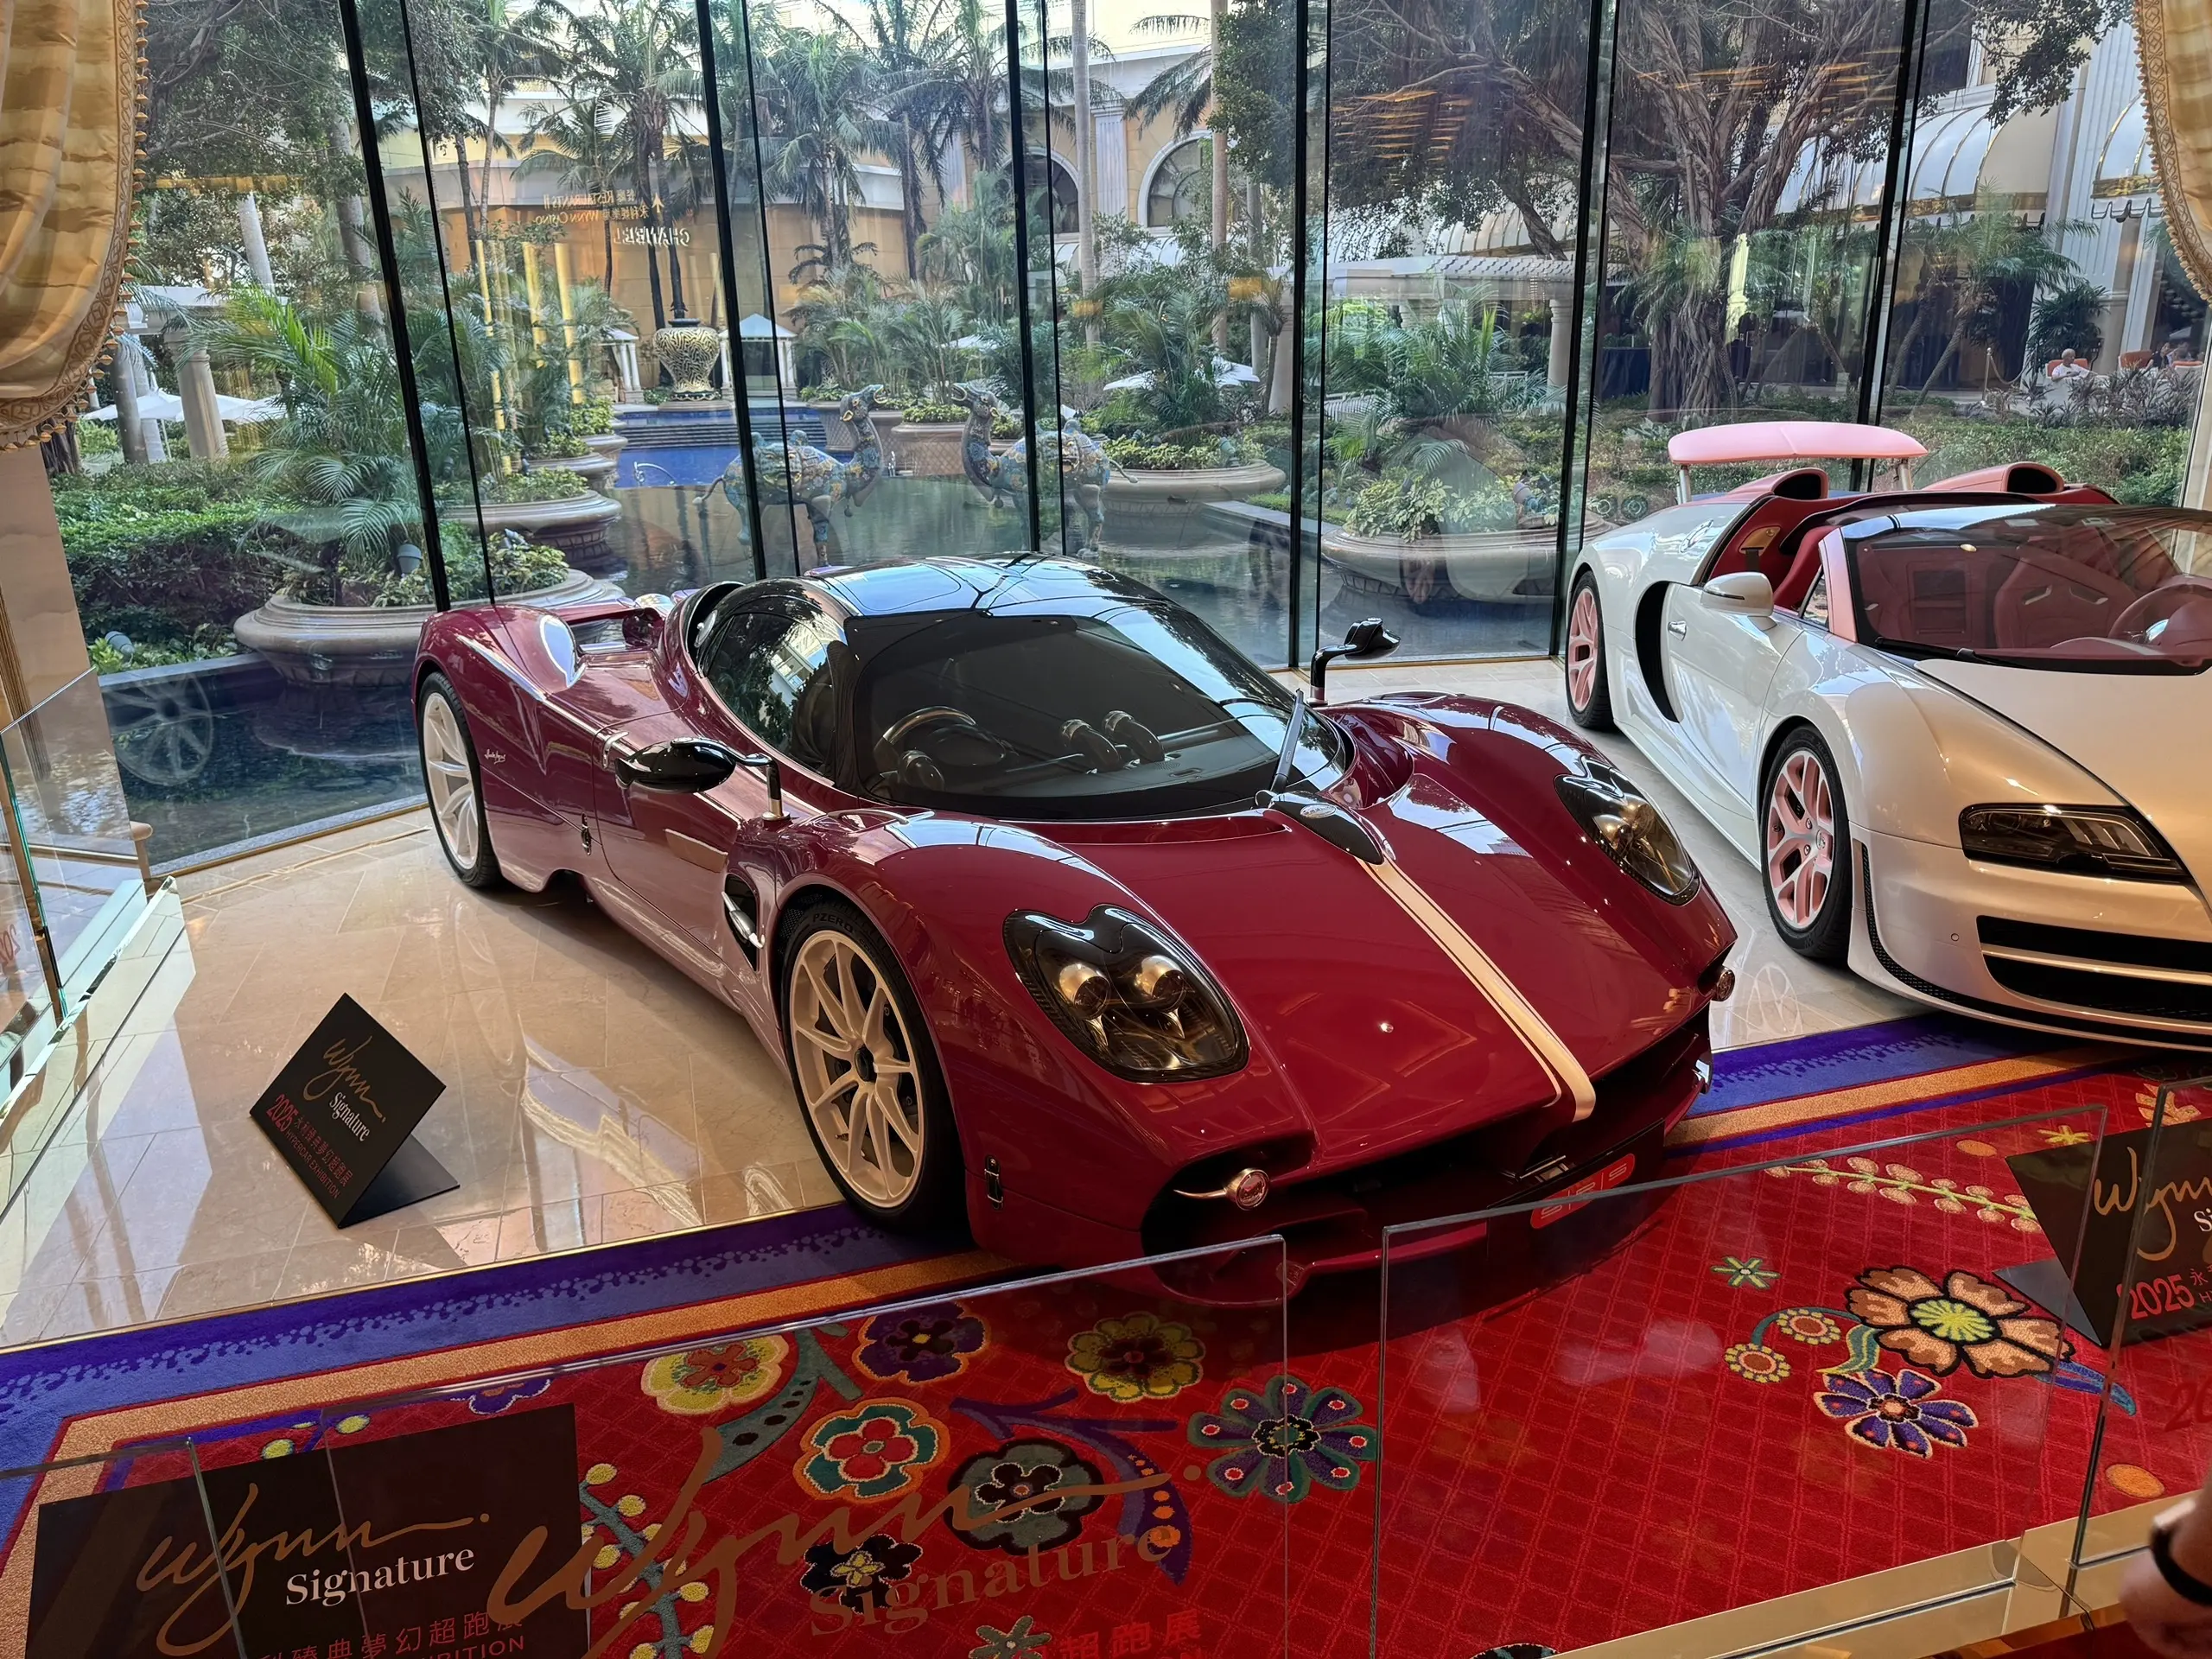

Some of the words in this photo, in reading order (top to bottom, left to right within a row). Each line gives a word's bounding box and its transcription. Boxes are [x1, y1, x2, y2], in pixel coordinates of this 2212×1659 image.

[266, 1094, 298, 1132] 2025
[329, 1092, 370, 1141] Signature
[308, 1160, 340, 1198] EXHIBITION
[2117, 1274, 2195, 1319] 2025
[286, 1548, 474, 1607] Signature
[810, 1525, 1173, 1637] Signature
